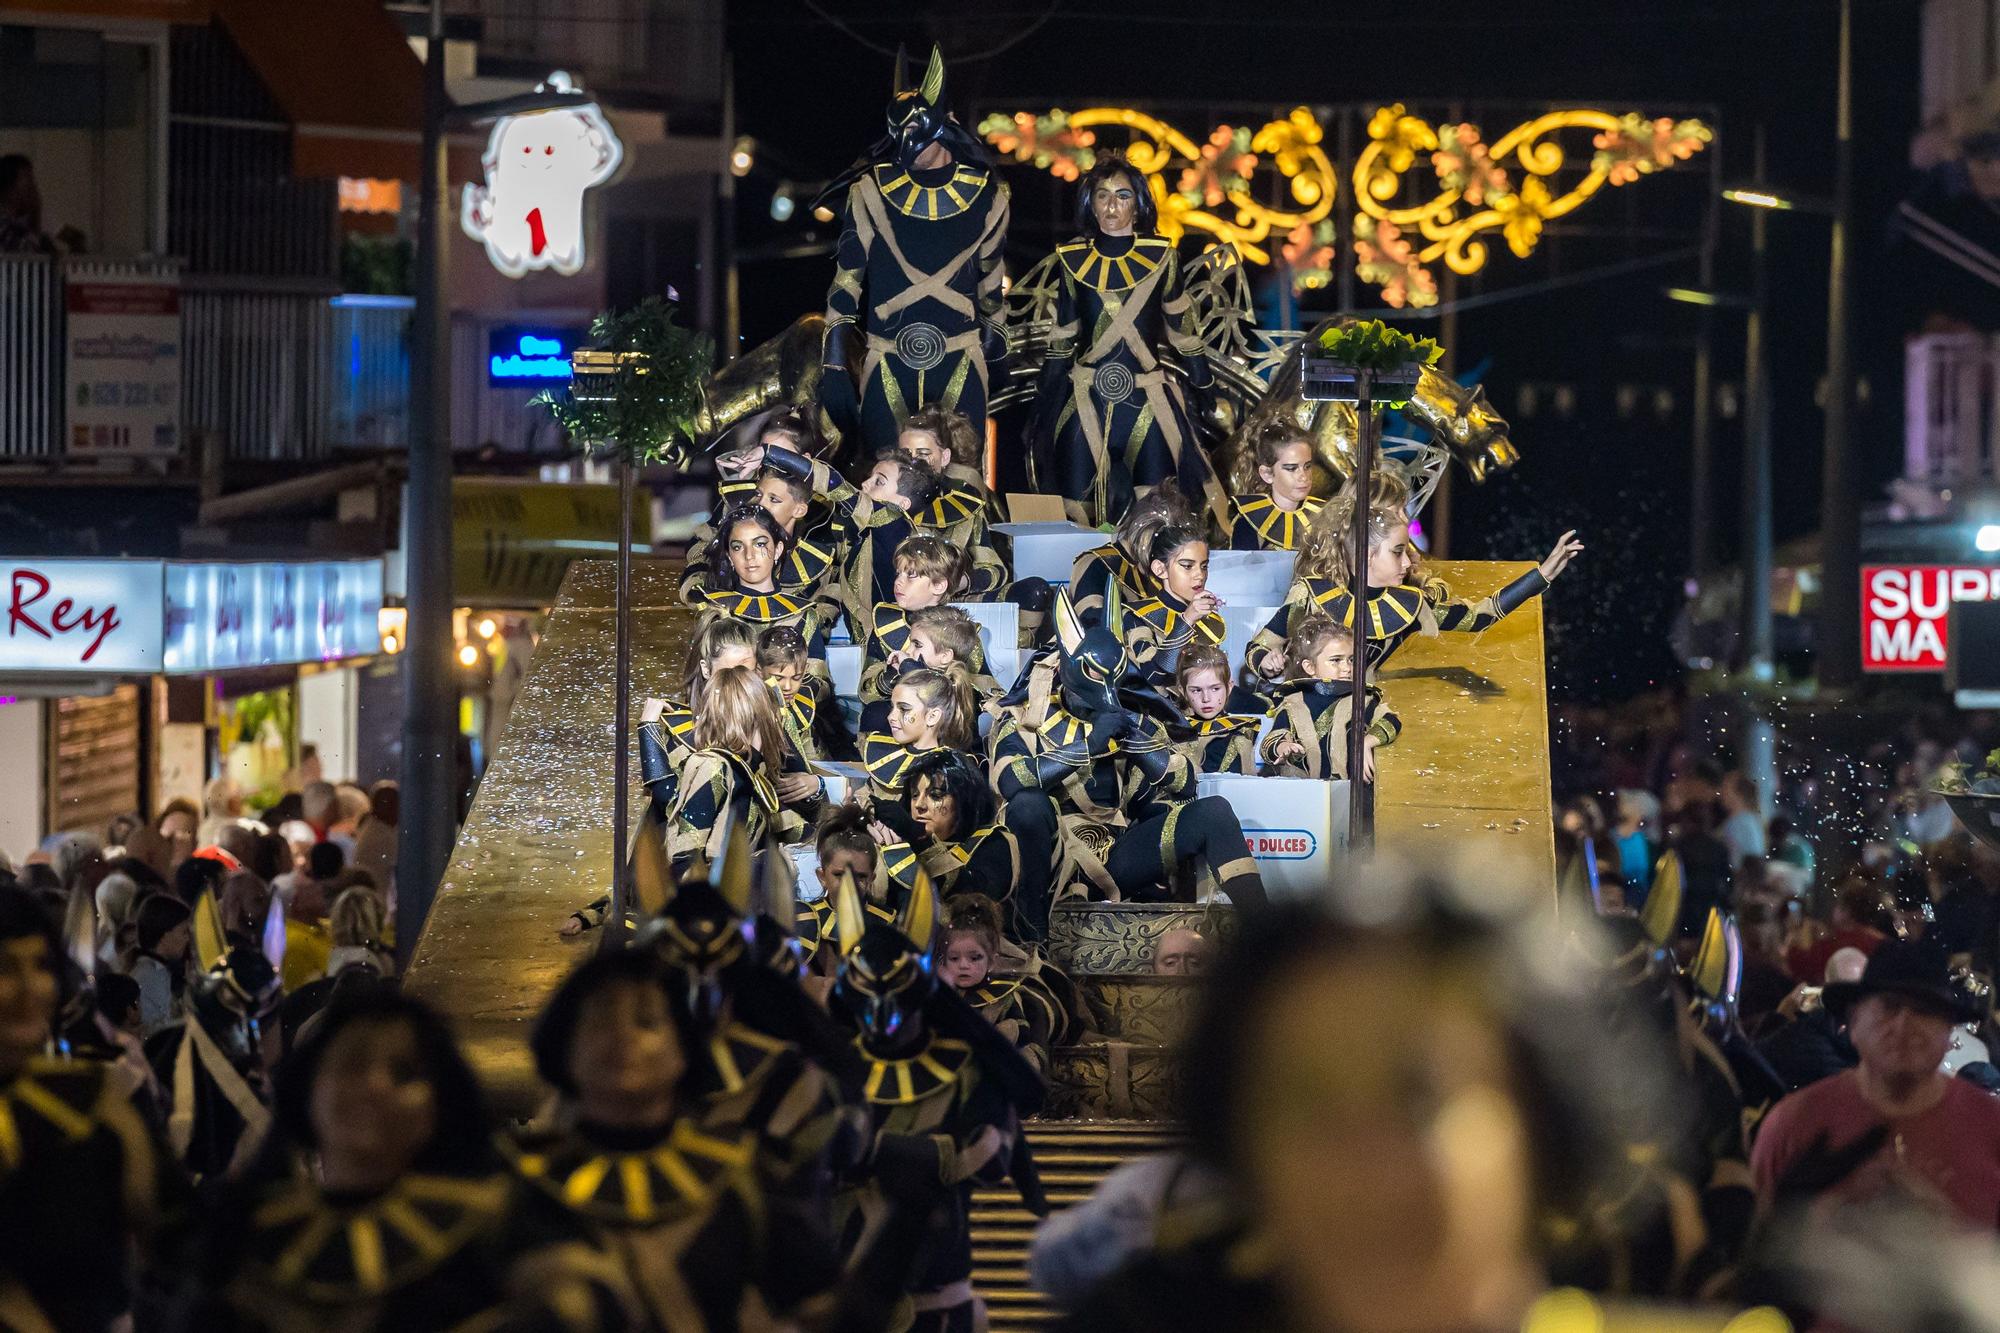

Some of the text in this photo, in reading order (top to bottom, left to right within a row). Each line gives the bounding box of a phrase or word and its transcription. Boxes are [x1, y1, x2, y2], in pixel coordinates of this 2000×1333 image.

[7, 568, 121, 662] Rey
[1870, 569, 2000, 619] SUP
[1259, 838, 1307, 852] DULCES
